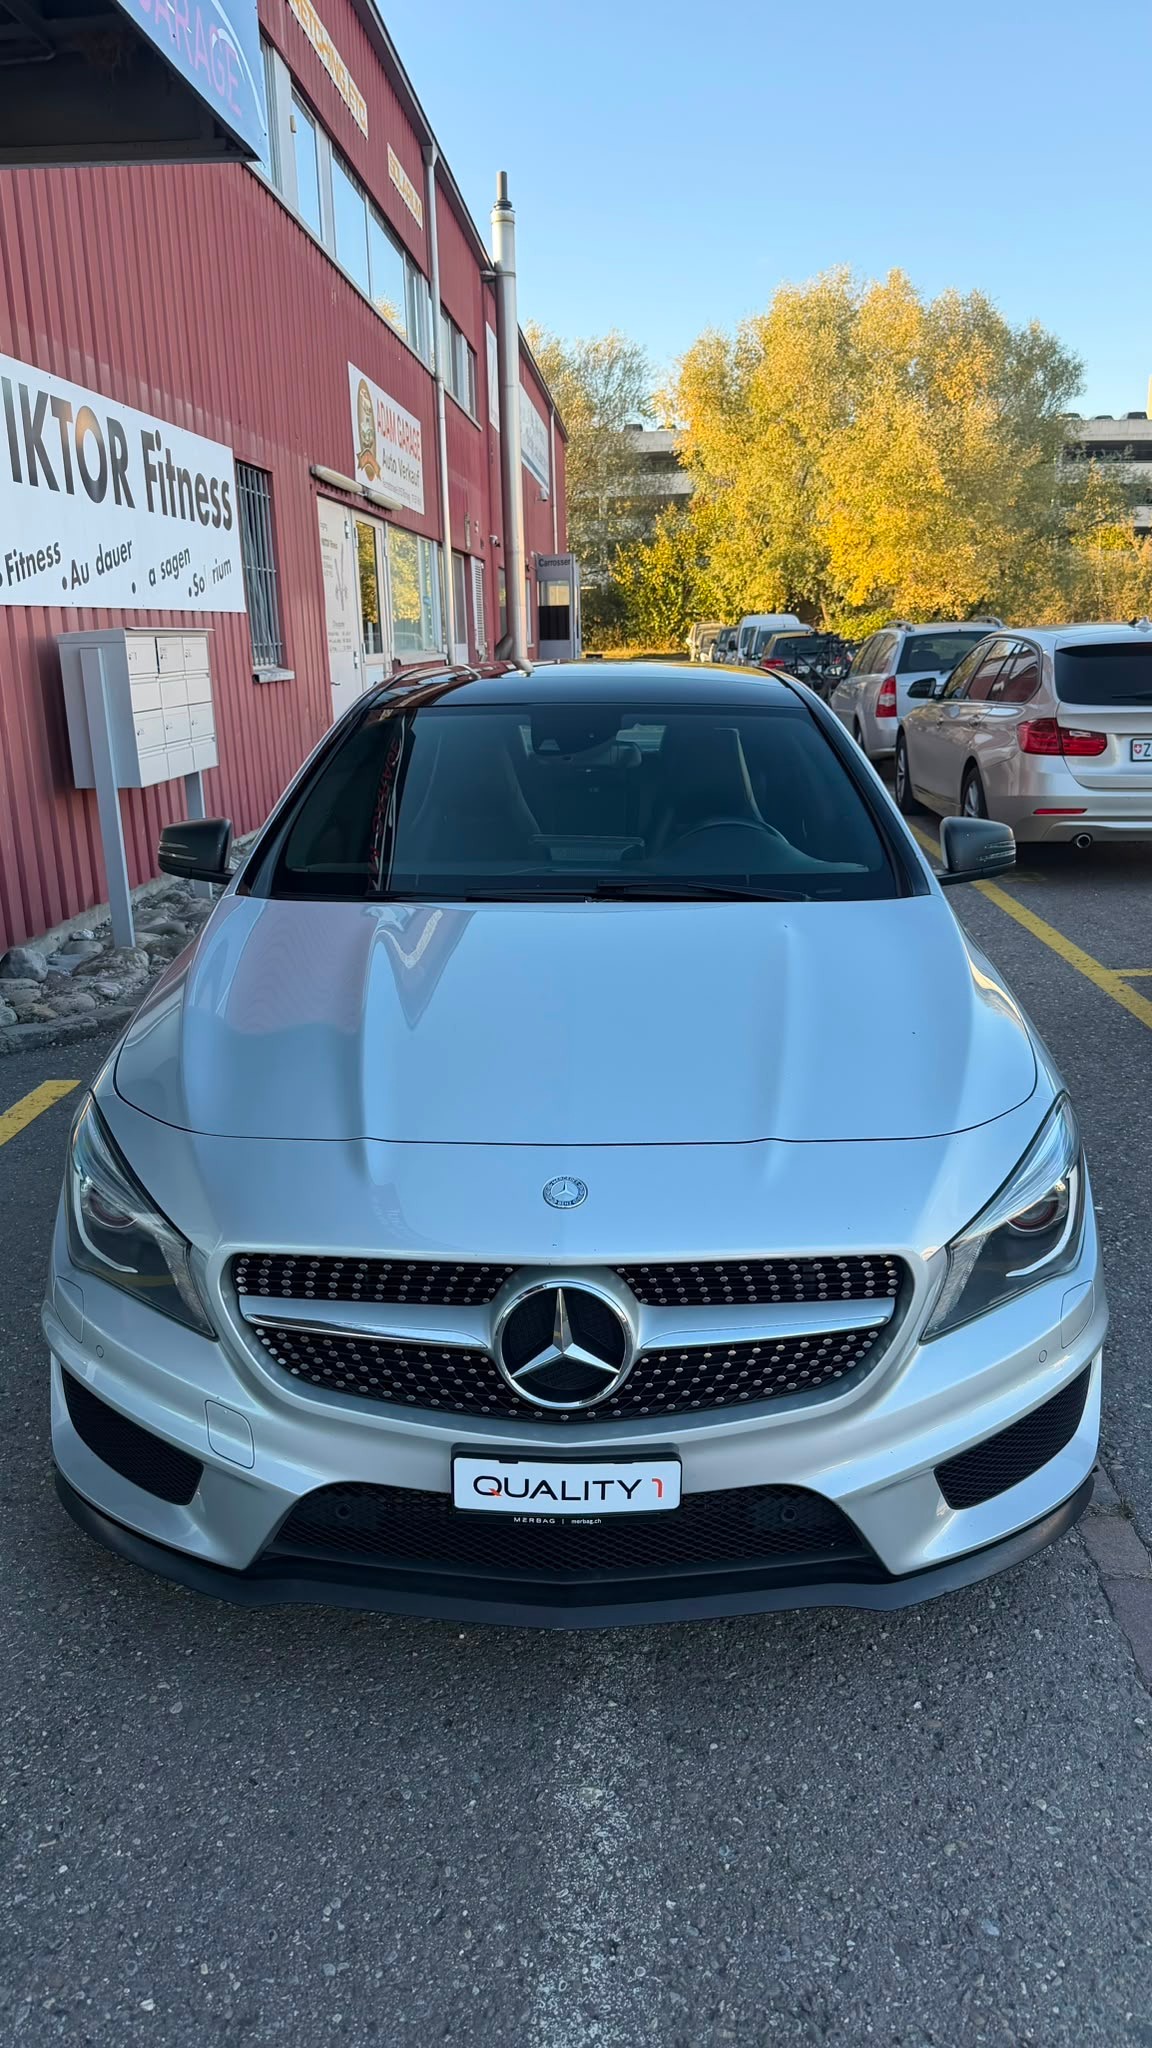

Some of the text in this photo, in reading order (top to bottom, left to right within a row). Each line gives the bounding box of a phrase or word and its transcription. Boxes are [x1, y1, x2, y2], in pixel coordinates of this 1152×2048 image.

[382, 447, 397, 475] Auto
[140, 429, 233, 531] Fitness
[5, 541, 61, 587] Fitness
[473, 1475, 643, 1501] QUALITY
[513, 1516, 602, 1526] MERBAG merbag.ch
